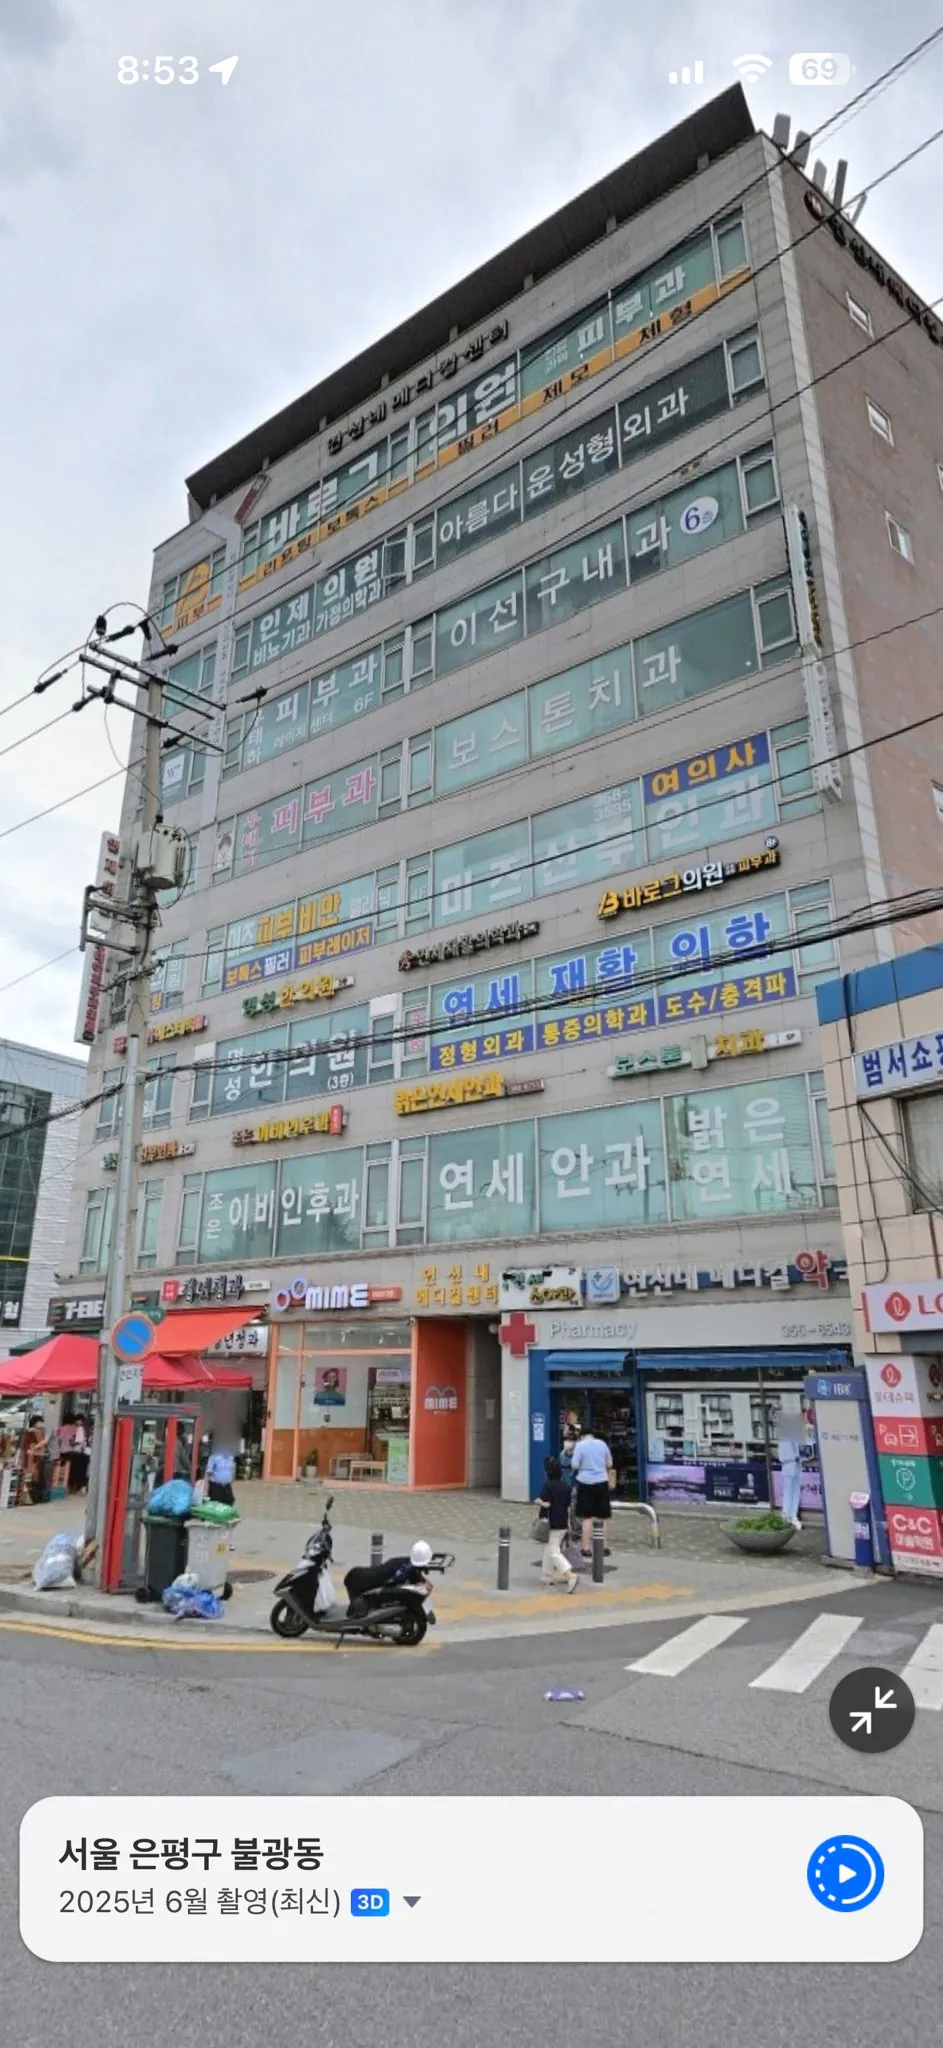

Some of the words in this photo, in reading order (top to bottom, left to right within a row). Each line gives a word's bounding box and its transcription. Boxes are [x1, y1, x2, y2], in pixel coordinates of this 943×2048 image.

[450, 516, 672, 648] 이선구내과
[275, 654, 379, 723] 피부과
[448, 645, 682, 770] 보스톤치과
[652, 741, 756, 797] 여의사
[270, 766, 377, 834] 피부과
[256, 890, 342, 948] 피부비만
[298, 925, 371, 966] 피부레이저
[225, 960, 262, 987] 보톡스
[263, 949, 290, 976] 필러
[438, 1029, 525, 1067] 정형외과
[542, 1003, 648, 1046] 통증의학과
[665, 971, 787, 1018] 도수/충격파
[687, 1097, 786, 1152] 밝은
[439, 1152, 524, 1211] 연세
[550, 1135, 651, 1199] 안과
[692, 1147, 794, 1202] 연세
[206, 1192, 224, 1239] 조은
[228, 1178, 359, 1231] 이비인후과
[305, 1283, 369, 1310] MIME
[550, 1321, 638, 1341] Pharmacy
[833, 1383, 852, 1396] IBK
[892, 1513, 932, 1535] C&C
